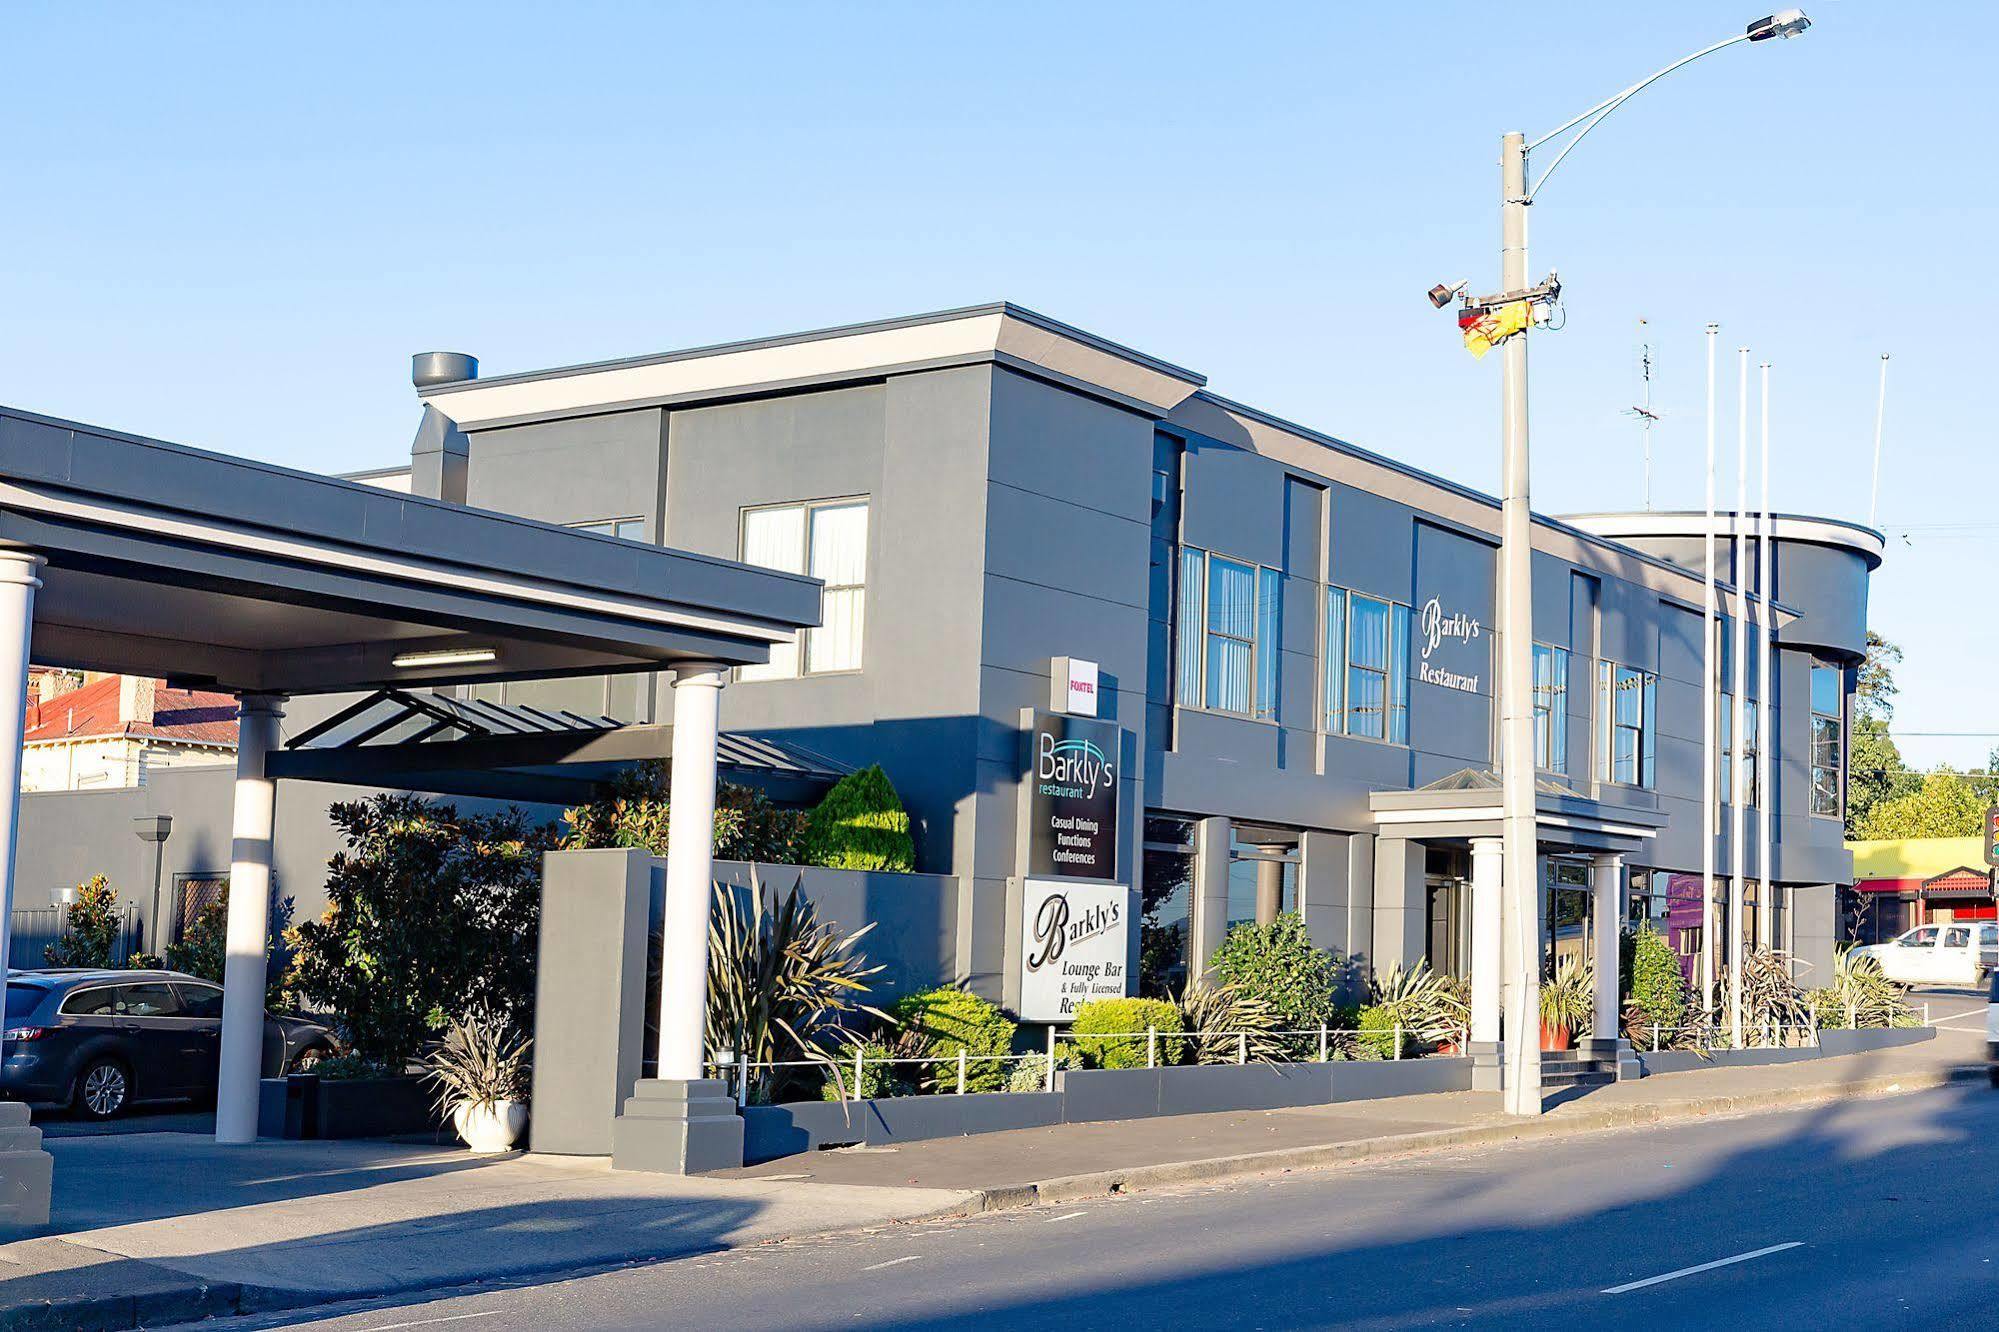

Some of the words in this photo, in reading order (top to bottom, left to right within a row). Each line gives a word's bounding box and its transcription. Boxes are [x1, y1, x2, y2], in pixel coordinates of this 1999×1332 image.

[1421, 594, 1480, 659] Barkly's
[1070, 680, 1094, 694] FOXTEL
[1419, 662, 1479, 693] Restaurant
[1039, 732, 1113, 800] Barkly's
[1039, 783, 1083, 799] restaurant
[1051, 815, 1075, 830] Casual
[1075, 818, 1099, 835] Dining
[1057, 833, 1092, 848] Functions
[1053, 849, 1096, 865] Conferences
[1028, 890, 1120, 971] Barkly's
[1062, 961, 1101, 981] Lounge
[1104, 961, 1123, 977] Bar
[1061, 982, 1067, 993] &
[1070, 982, 1089, 993] Fully
[1091, 983, 1122, 994] Licensed
